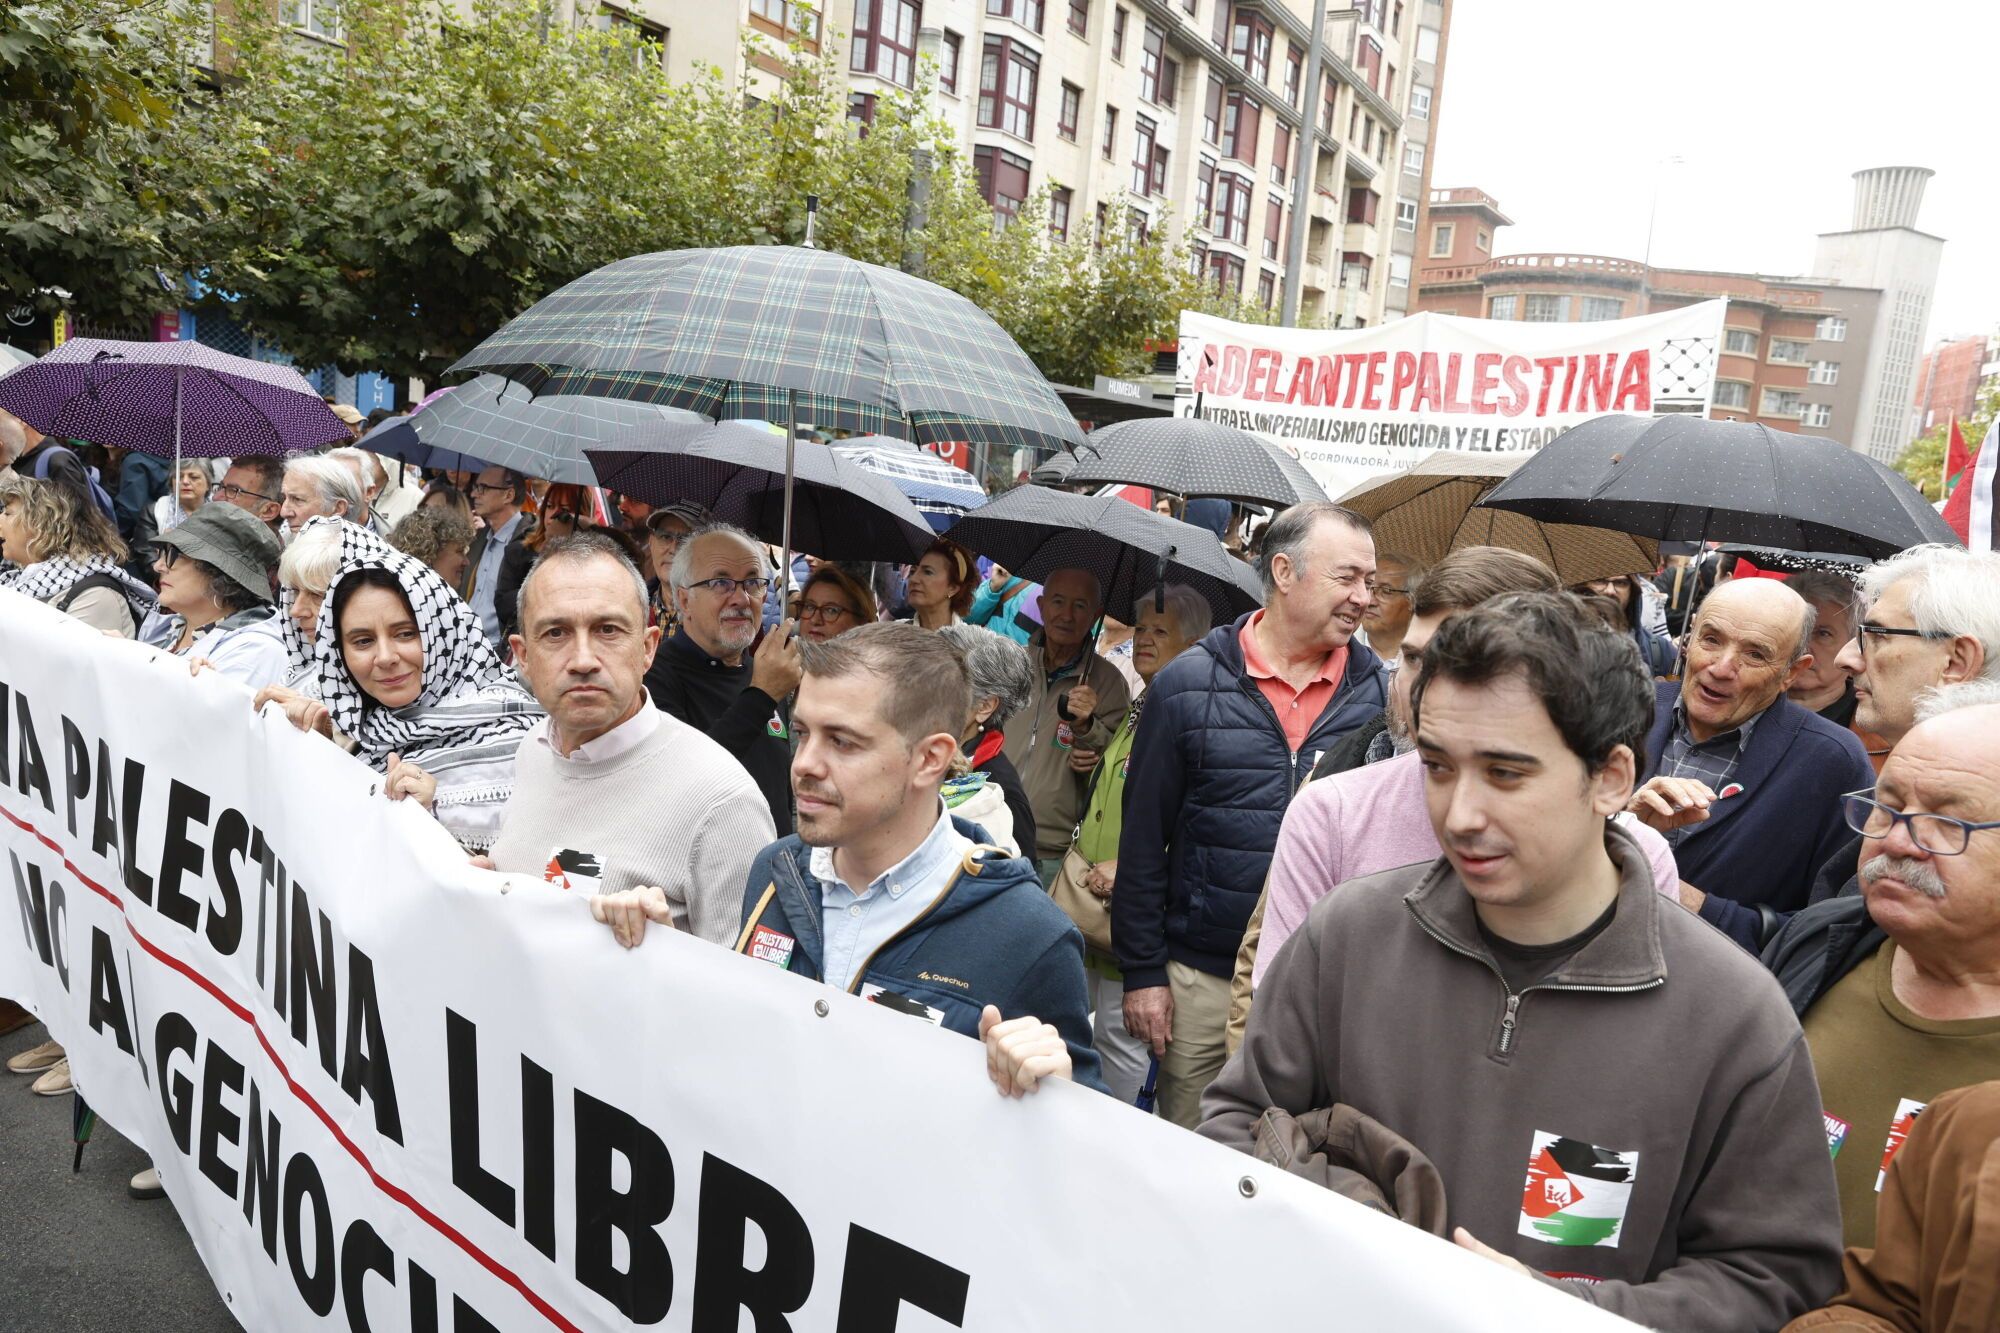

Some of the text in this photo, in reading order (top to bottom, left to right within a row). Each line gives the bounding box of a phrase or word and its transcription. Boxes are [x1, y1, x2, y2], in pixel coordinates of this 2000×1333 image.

[1108, 379, 1141, 399] HUMEDAL
[1194, 343, 1651, 417] ADELANTE PALESTINA
[1184, 404, 1238, 429] CNTRA
[1254, 412, 1366, 445] IMPERIALISMO
[1369, 422, 1450, 449] GENOCIDA
[1455, 427, 1468, 450] Y
[1469, 427, 1492, 452] EL
[1303, 450, 1390, 468] COORDINADORA
[61, 713, 404, 1148] PALESTINA
[755, 931, 795, 953] PALESTINA
[932, 973, 969, 989] Quechua
[154, 1012, 502, 1333] GENOC
